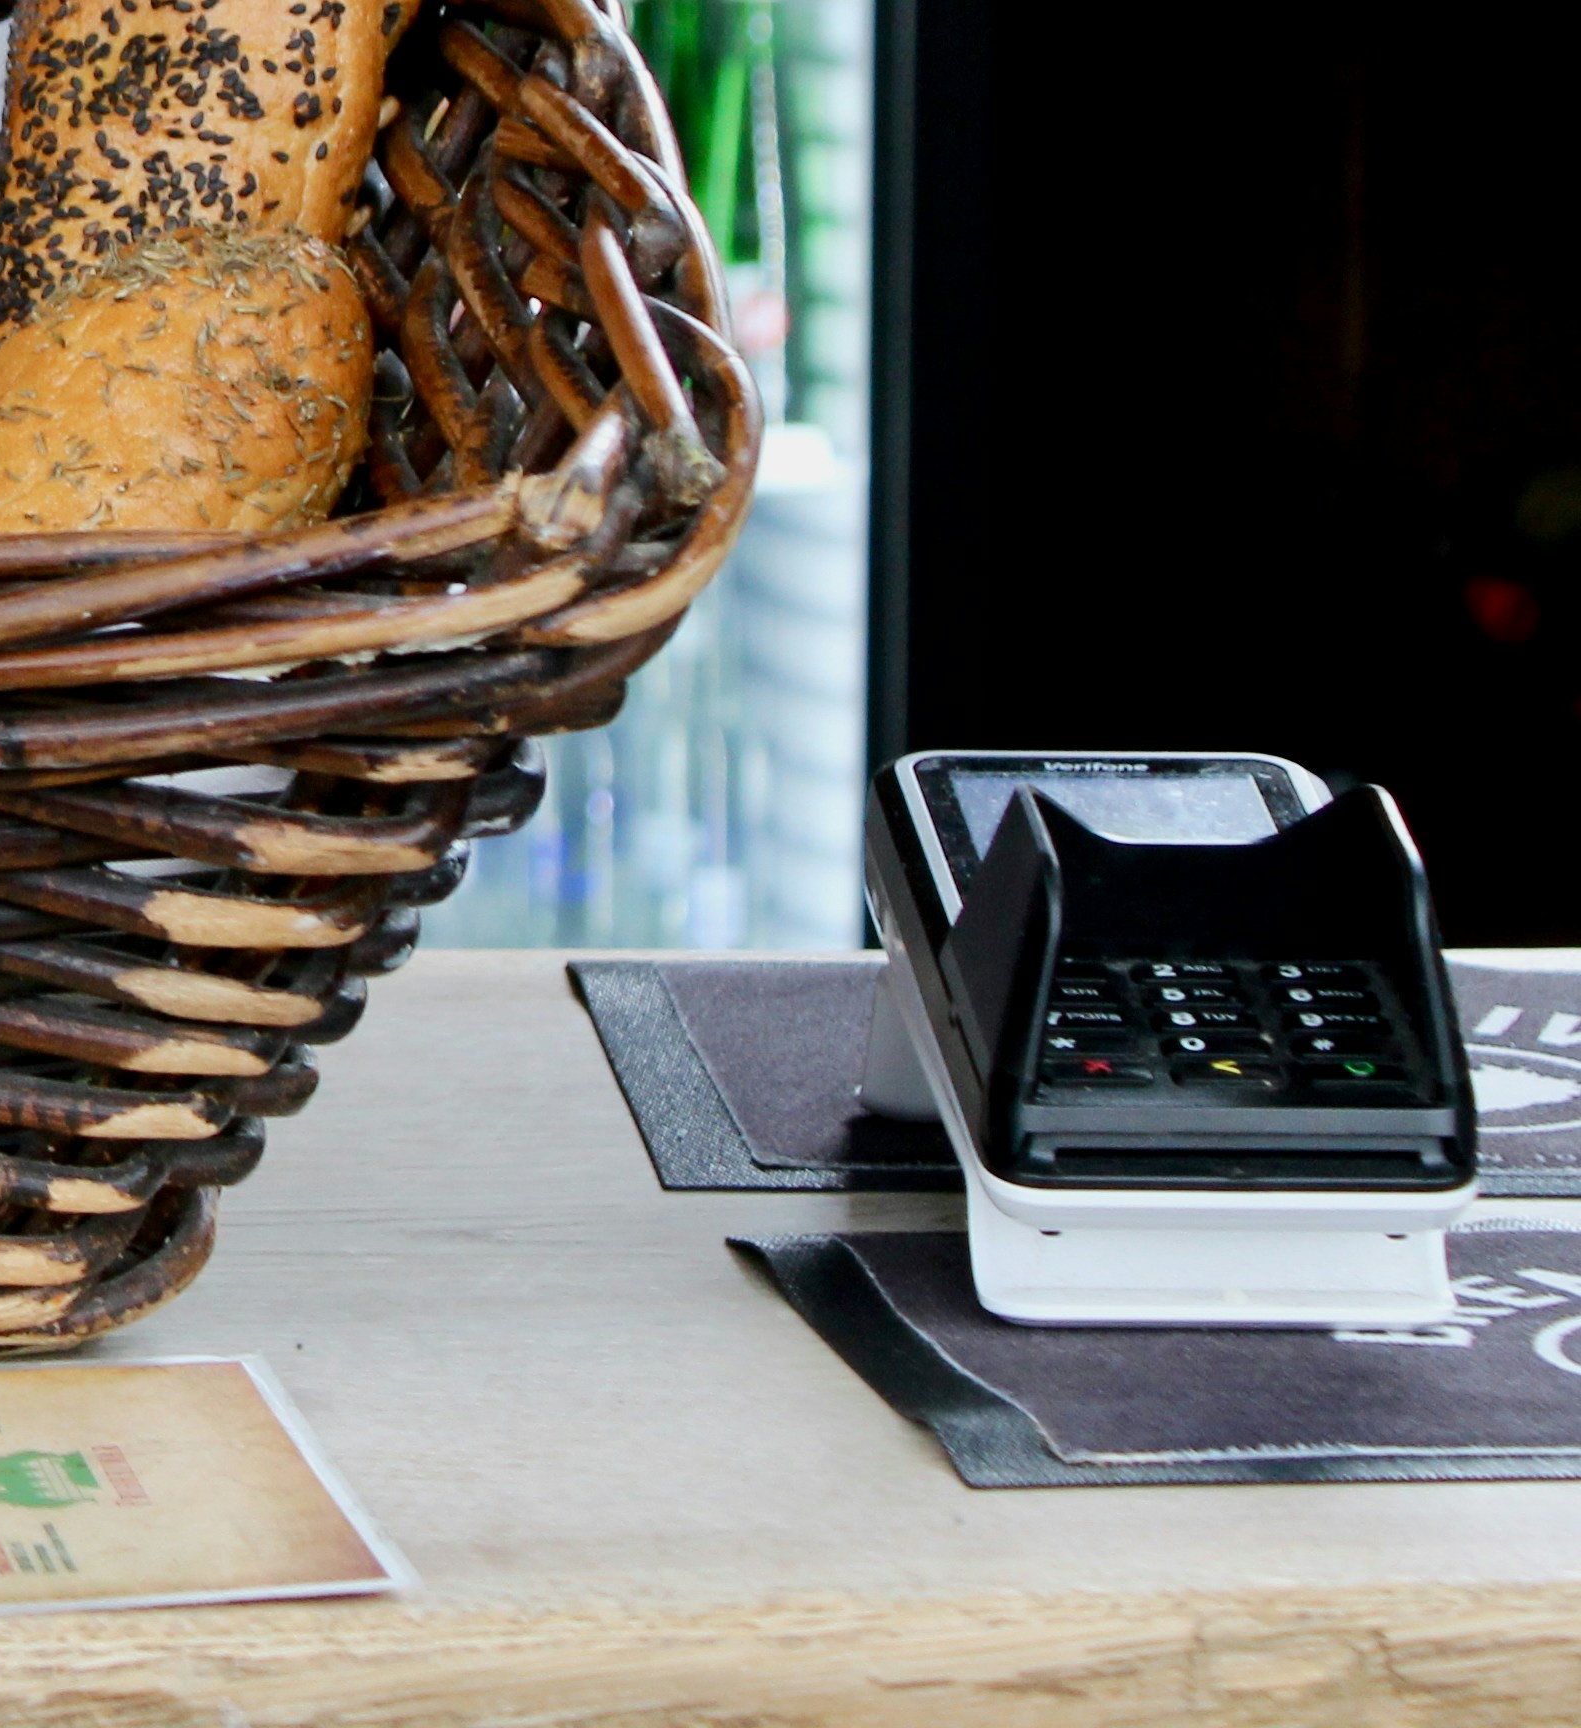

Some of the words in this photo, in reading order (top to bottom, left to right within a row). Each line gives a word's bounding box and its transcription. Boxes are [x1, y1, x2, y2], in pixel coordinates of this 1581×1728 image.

[1043, 761, 1150, 773] Verifone
[1151, 963, 1178, 978] 2
[1277, 965, 1303, 980] 3
[1161, 987, 1187, 1003] 5
[1287, 988, 1314, 1003] 6
[1169, 1011, 1198, 1028] 8
[1298, 1013, 1325, 1028] 9
[1179, 1036, 1207, 1053] 0
